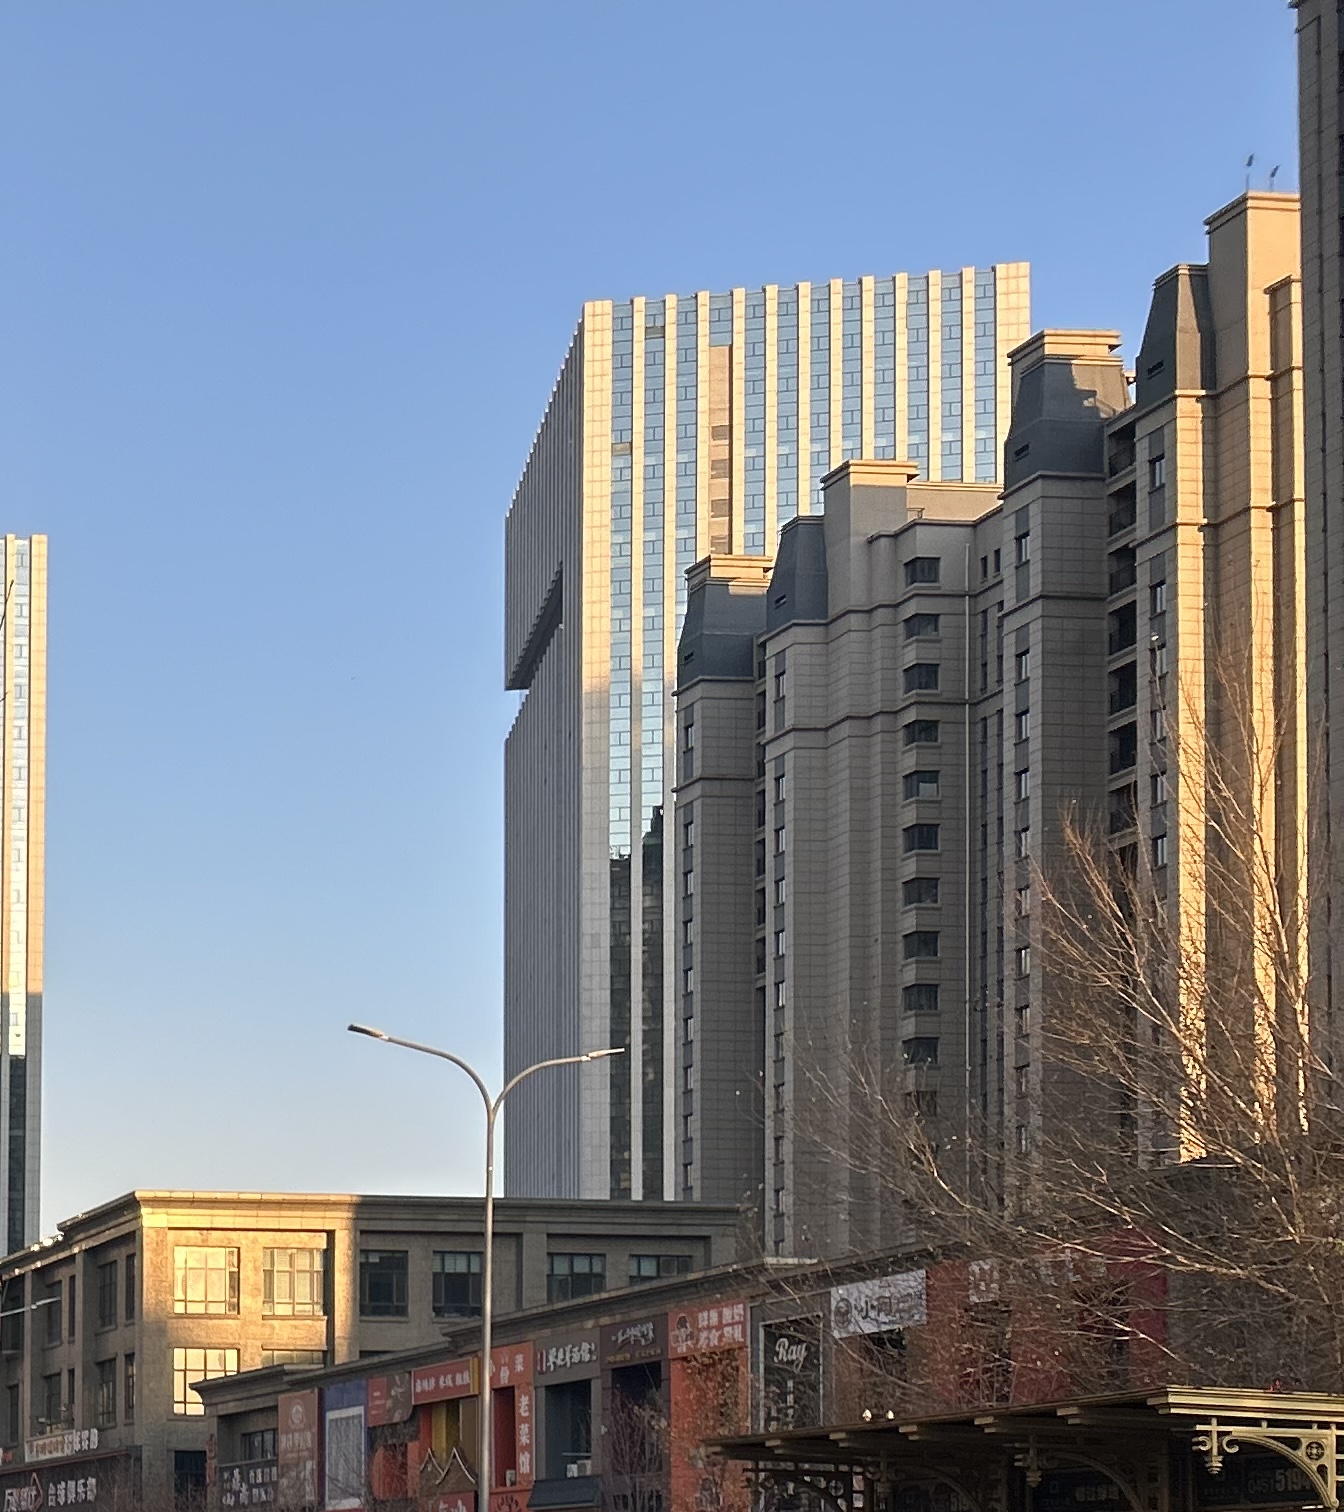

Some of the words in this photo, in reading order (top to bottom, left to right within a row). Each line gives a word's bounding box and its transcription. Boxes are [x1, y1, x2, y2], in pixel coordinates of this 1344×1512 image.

[773, 1337, 809, 1373] Ray
[519, 1395, 530, 1474] 老菜馆
[48, 1477, 97, 1507] 台球俱乐部
